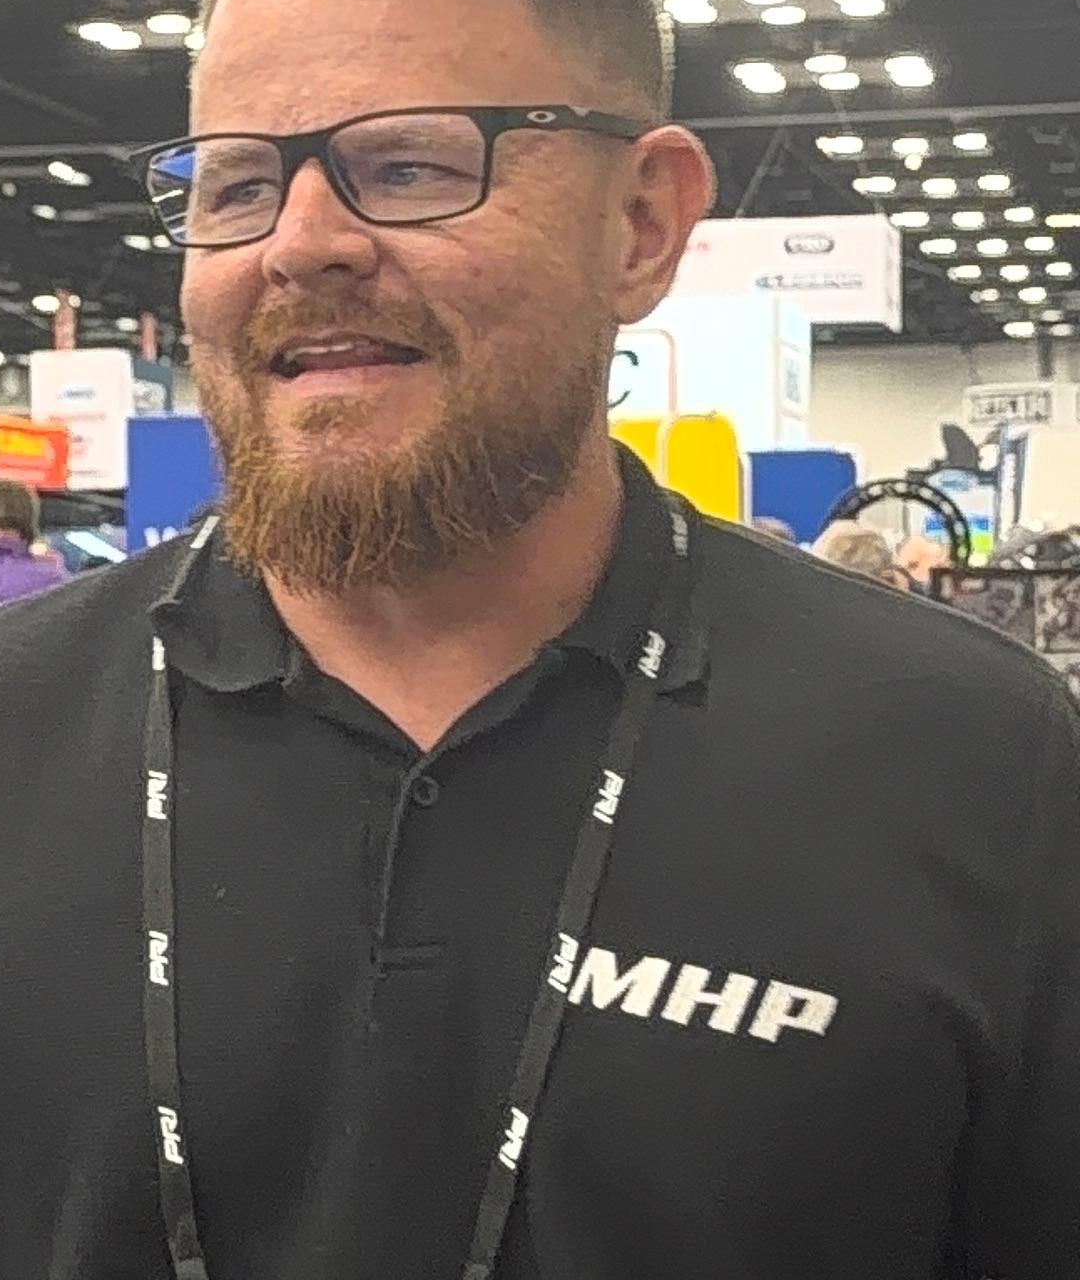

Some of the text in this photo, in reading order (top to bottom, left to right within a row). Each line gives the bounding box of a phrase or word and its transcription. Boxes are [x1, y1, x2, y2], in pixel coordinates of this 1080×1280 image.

[592, 769, 626, 824] PRI
[148, 930, 169, 986] PRI
[547, 932, 580, 994] PRI
[568, 947, 839, 1043] MHP
[157, 1106, 184, 1165] PRI
[498, 1107, 529, 1170] PRI
